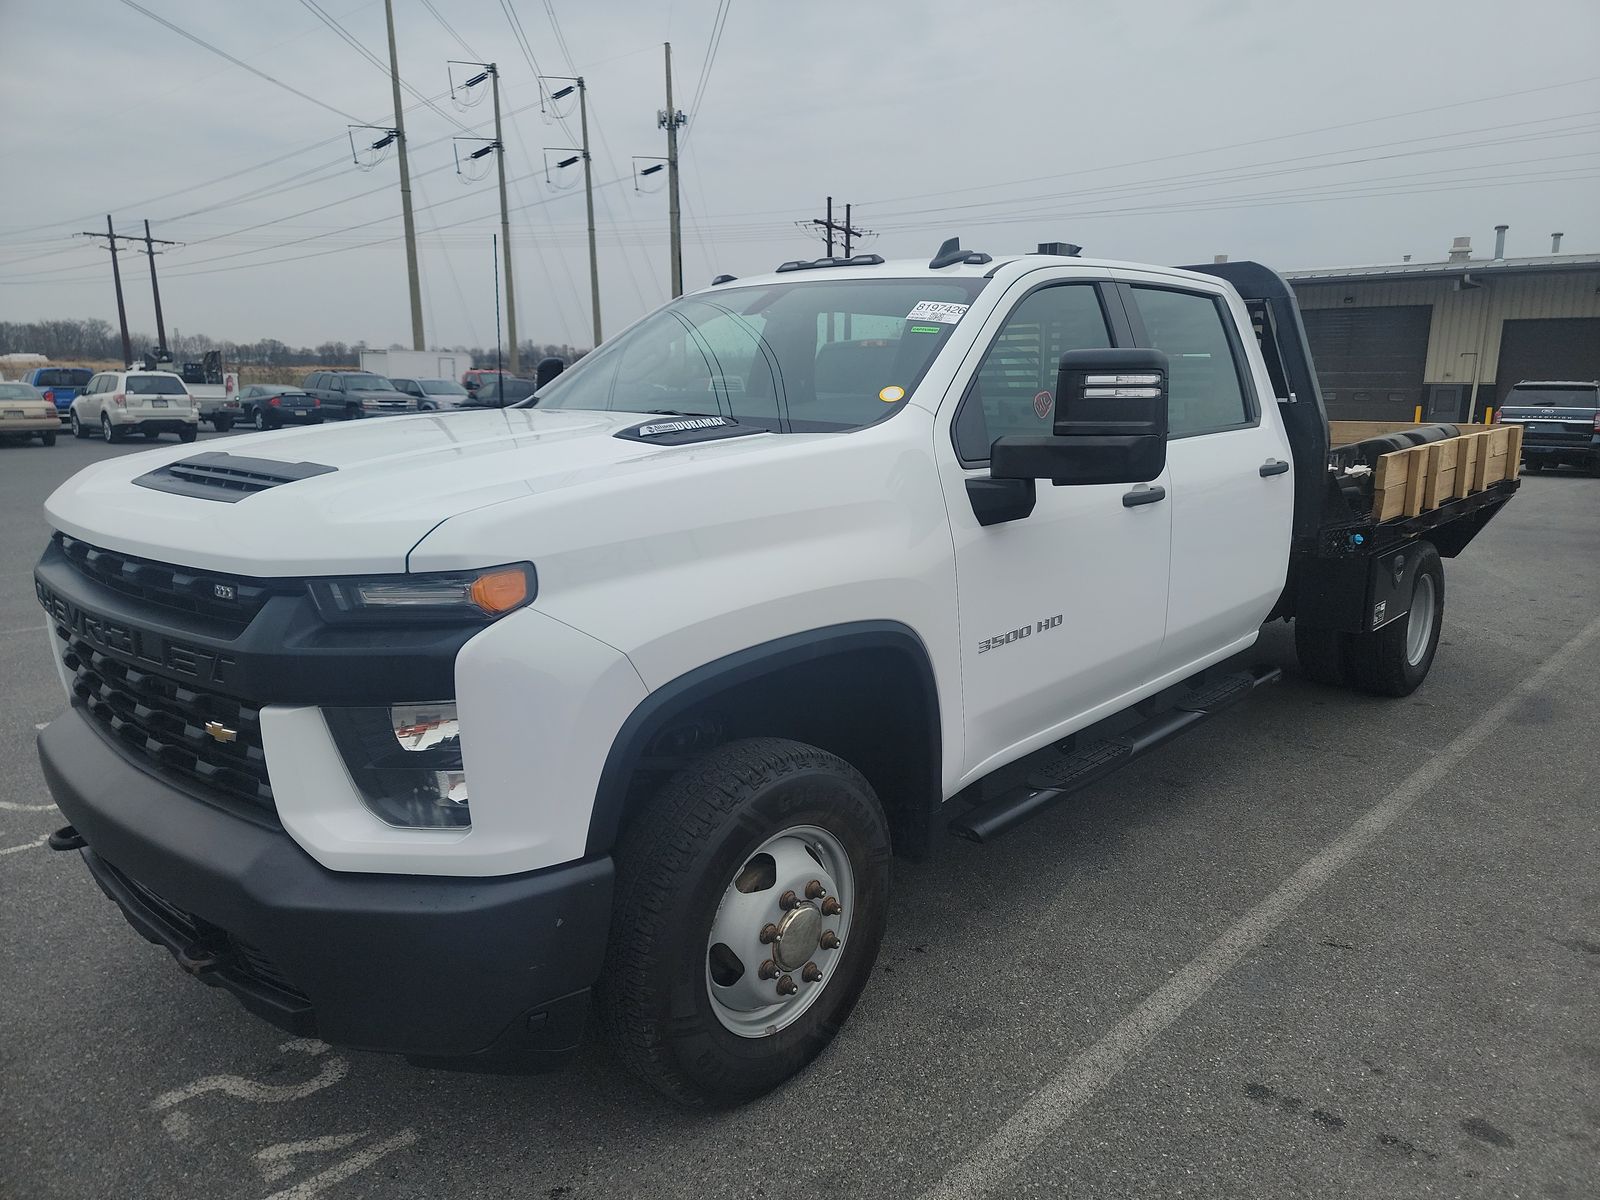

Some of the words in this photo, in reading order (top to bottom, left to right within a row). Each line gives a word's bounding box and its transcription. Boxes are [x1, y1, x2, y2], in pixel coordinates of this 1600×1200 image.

[916, 303, 968, 314] 8197426
[675, 417, 726, 430] DURAMAX
[36, 582, 236, 684] CHEVROLET
[978, 625, 1032, 654] 3500
[1036, 614, 1063, 633] HD
